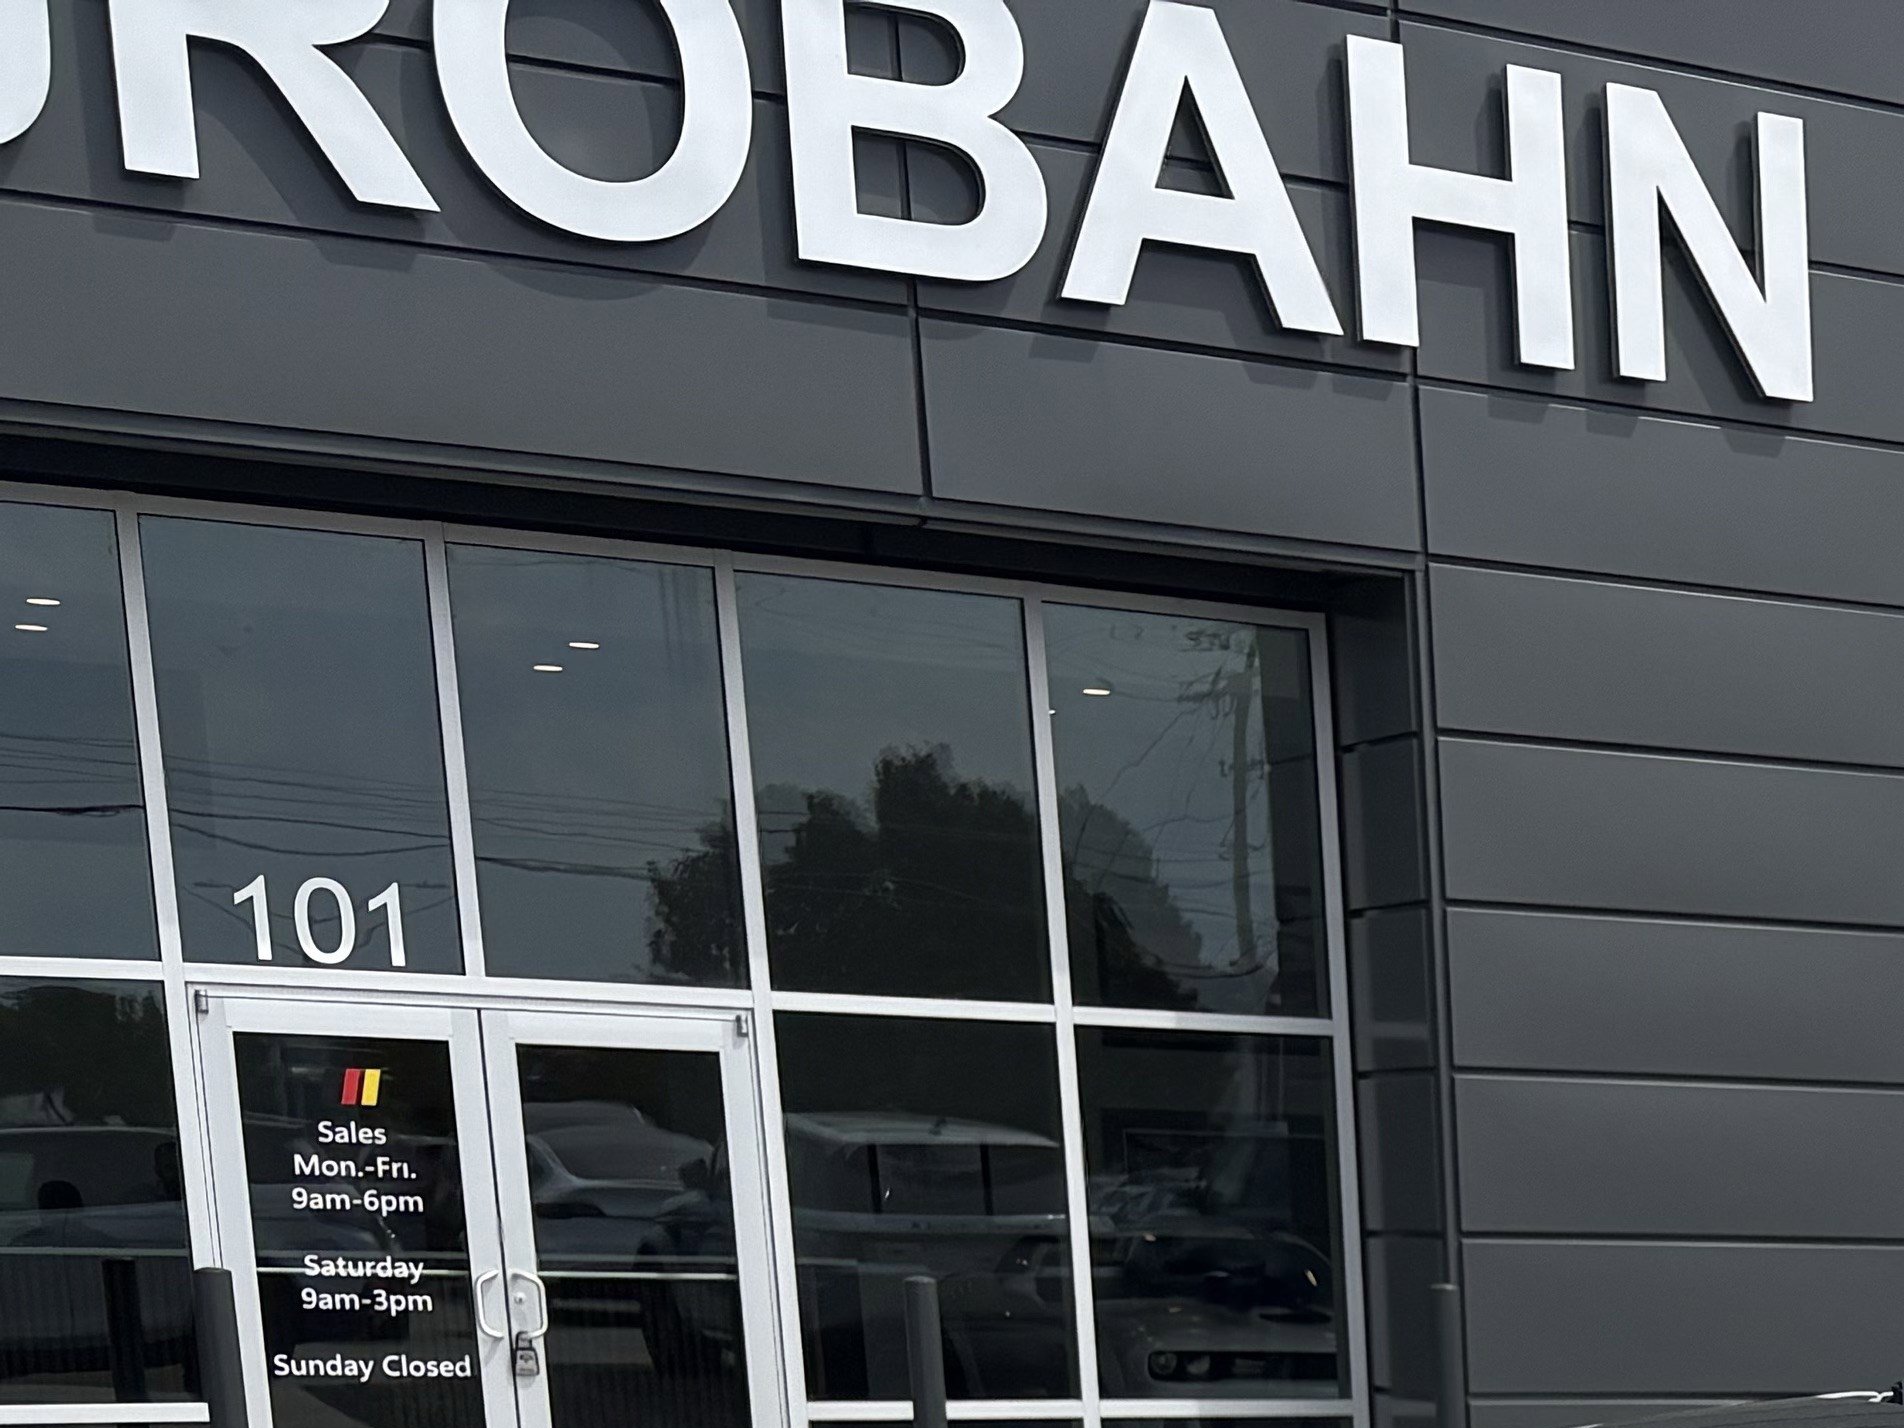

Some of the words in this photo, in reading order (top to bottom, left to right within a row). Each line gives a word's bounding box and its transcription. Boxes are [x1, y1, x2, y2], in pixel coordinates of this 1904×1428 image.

[233, 874, 406, 967] 101
[317, 1120, 387, 1145] Sales
[293, 1154, 417, 1179] Mon.-Fri.
[291, 1186, 424, 1216] 9am-6pm
[303, 1254, 425, 1284] Saturday
[301, 1288, 433, 1317] 9am-3pm
[273, 1354, 373, 1382] Sunday
[382, 1354, 472, 1378] Closed
